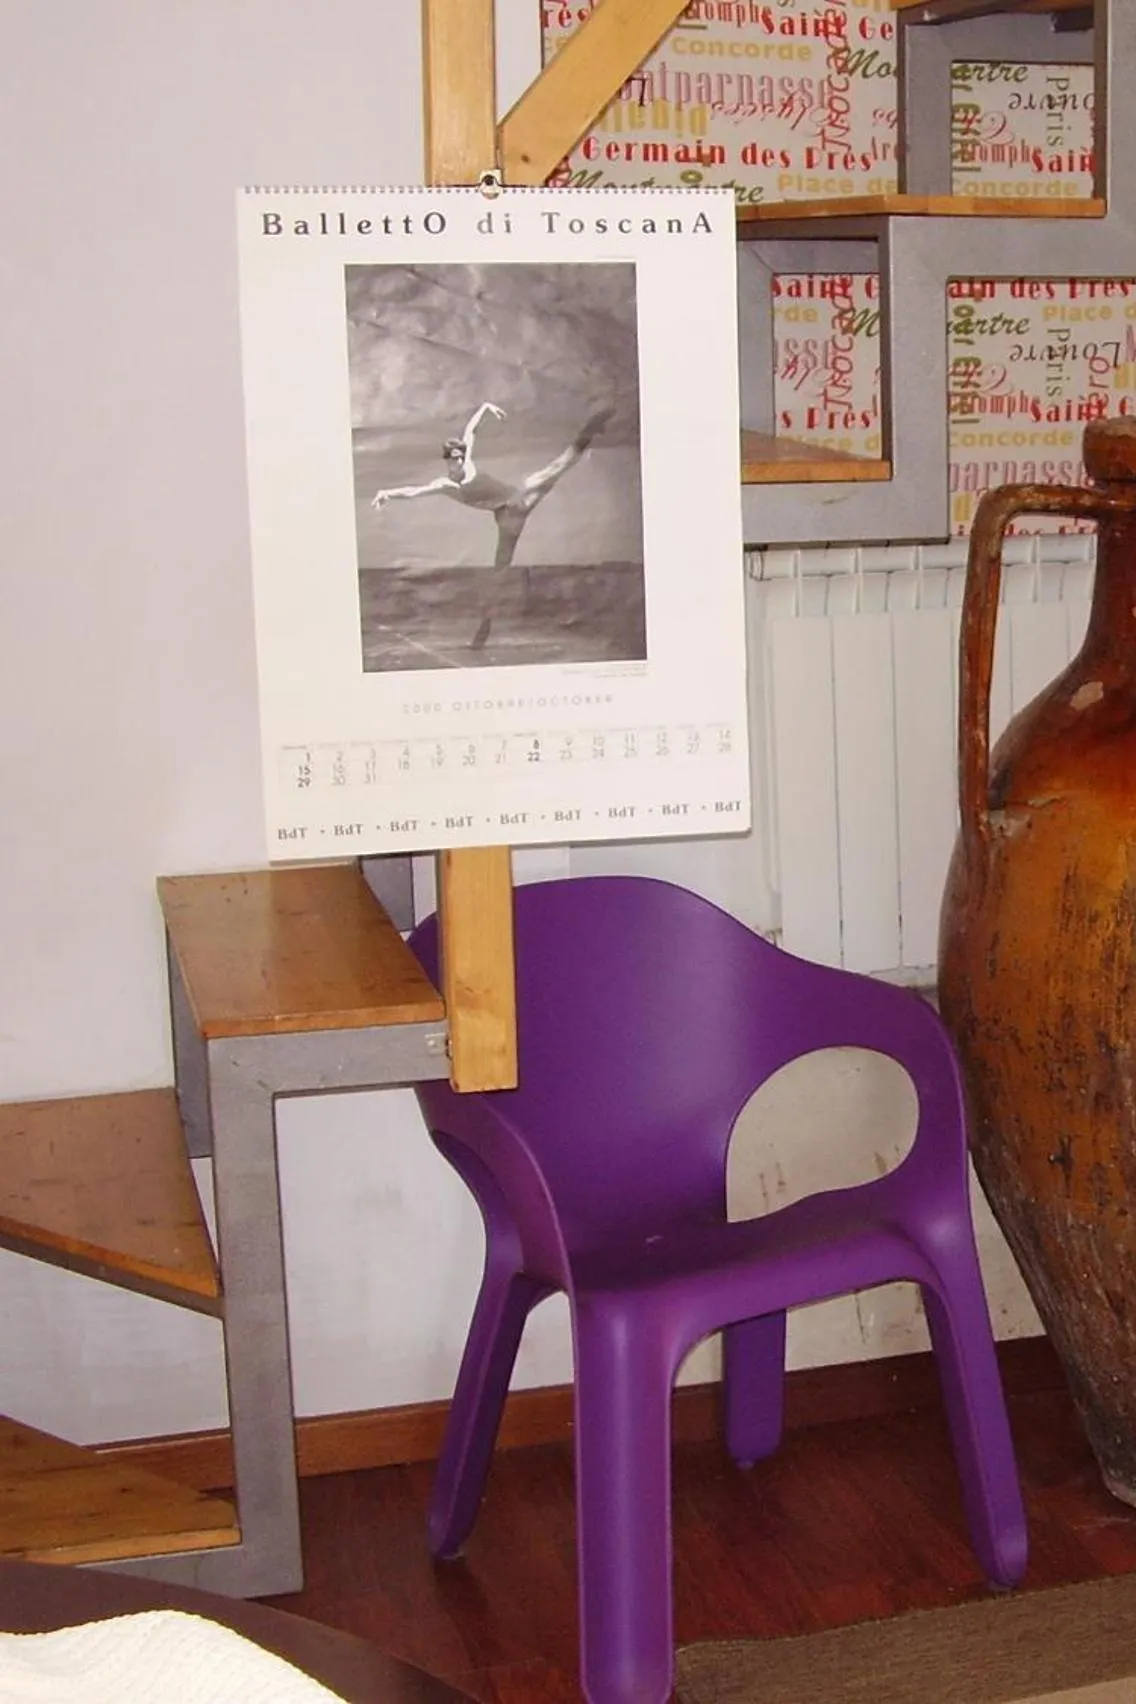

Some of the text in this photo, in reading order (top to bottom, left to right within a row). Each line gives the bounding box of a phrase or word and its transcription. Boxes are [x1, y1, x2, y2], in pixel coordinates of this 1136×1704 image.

[669, 36, 814, 62] Concorde
[581, 135, 726, 165] Germain
[740, 143, 792, 169] des
[777, 174, 855, 194] Place
[262, 211, 713, 236] BallettO di ToscanA
[1009, 277, 1057, 300] des
[1041, 304, 1114, 322] Place
[277, 800, 742, 841] BdT BdT BdT BdT BdT BdT BdT BdT BdT
